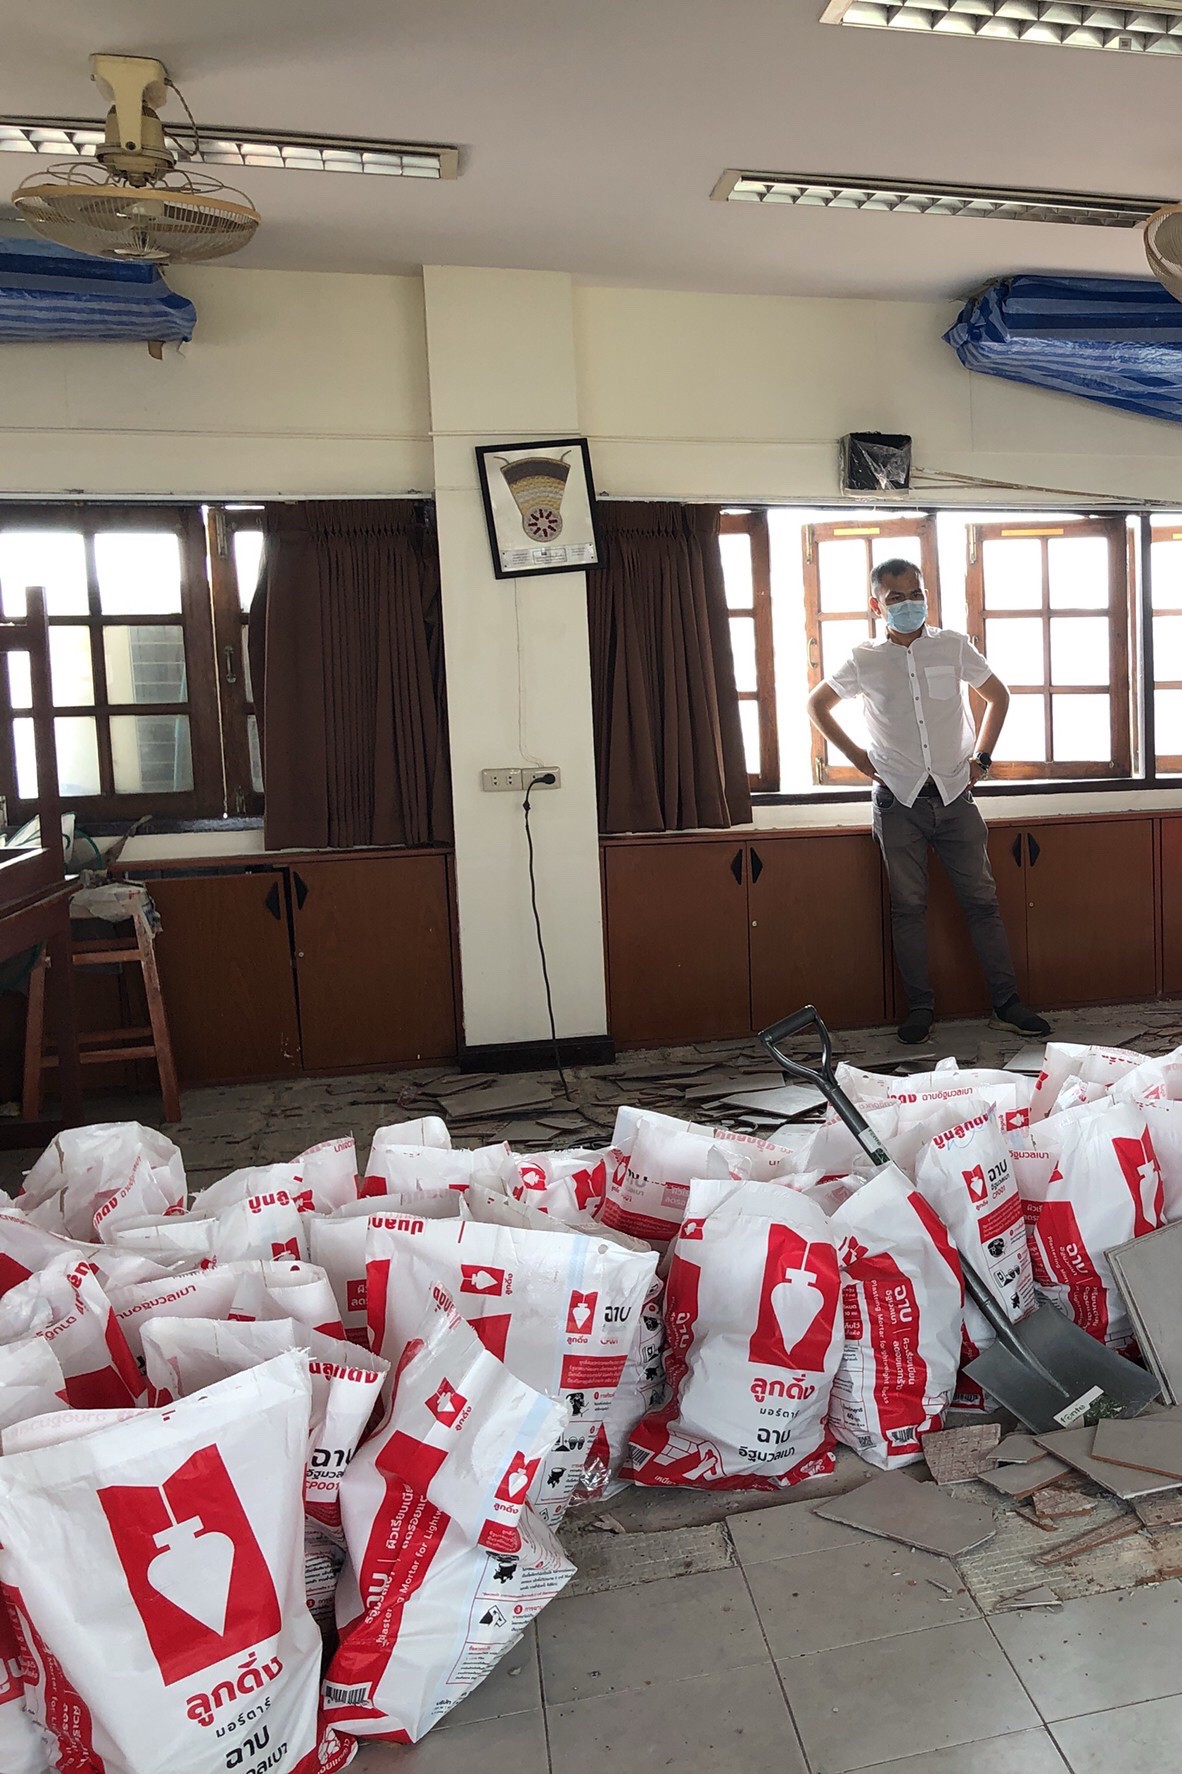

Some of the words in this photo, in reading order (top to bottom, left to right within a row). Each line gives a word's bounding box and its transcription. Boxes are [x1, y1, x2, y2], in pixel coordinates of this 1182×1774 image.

[988, 1158, 1007, 1182] ฉาบ
[1066, 1242, 1089, 1273] ฉาบ
[604, 1304, 632, 1323] ฉาบ
[894, 1285, 913, 1323] ฉาบ
[751, 1373, 816, 1403] ลูกดิ่ง
[757, 1428, 791, 1444] ฉาบ
[738, 1445, 796, 1463] อิฐมวลเบา
[400, 1560, 420, 1593] Mortar
[415, 1542, 428, 1558] for
[186, 1651, 284, 1728] ลูกดิ่ง
[216, 1696, 272, 1738] มอร์ตาร์
[226, 1725, 270, 1769] ฉาบ
